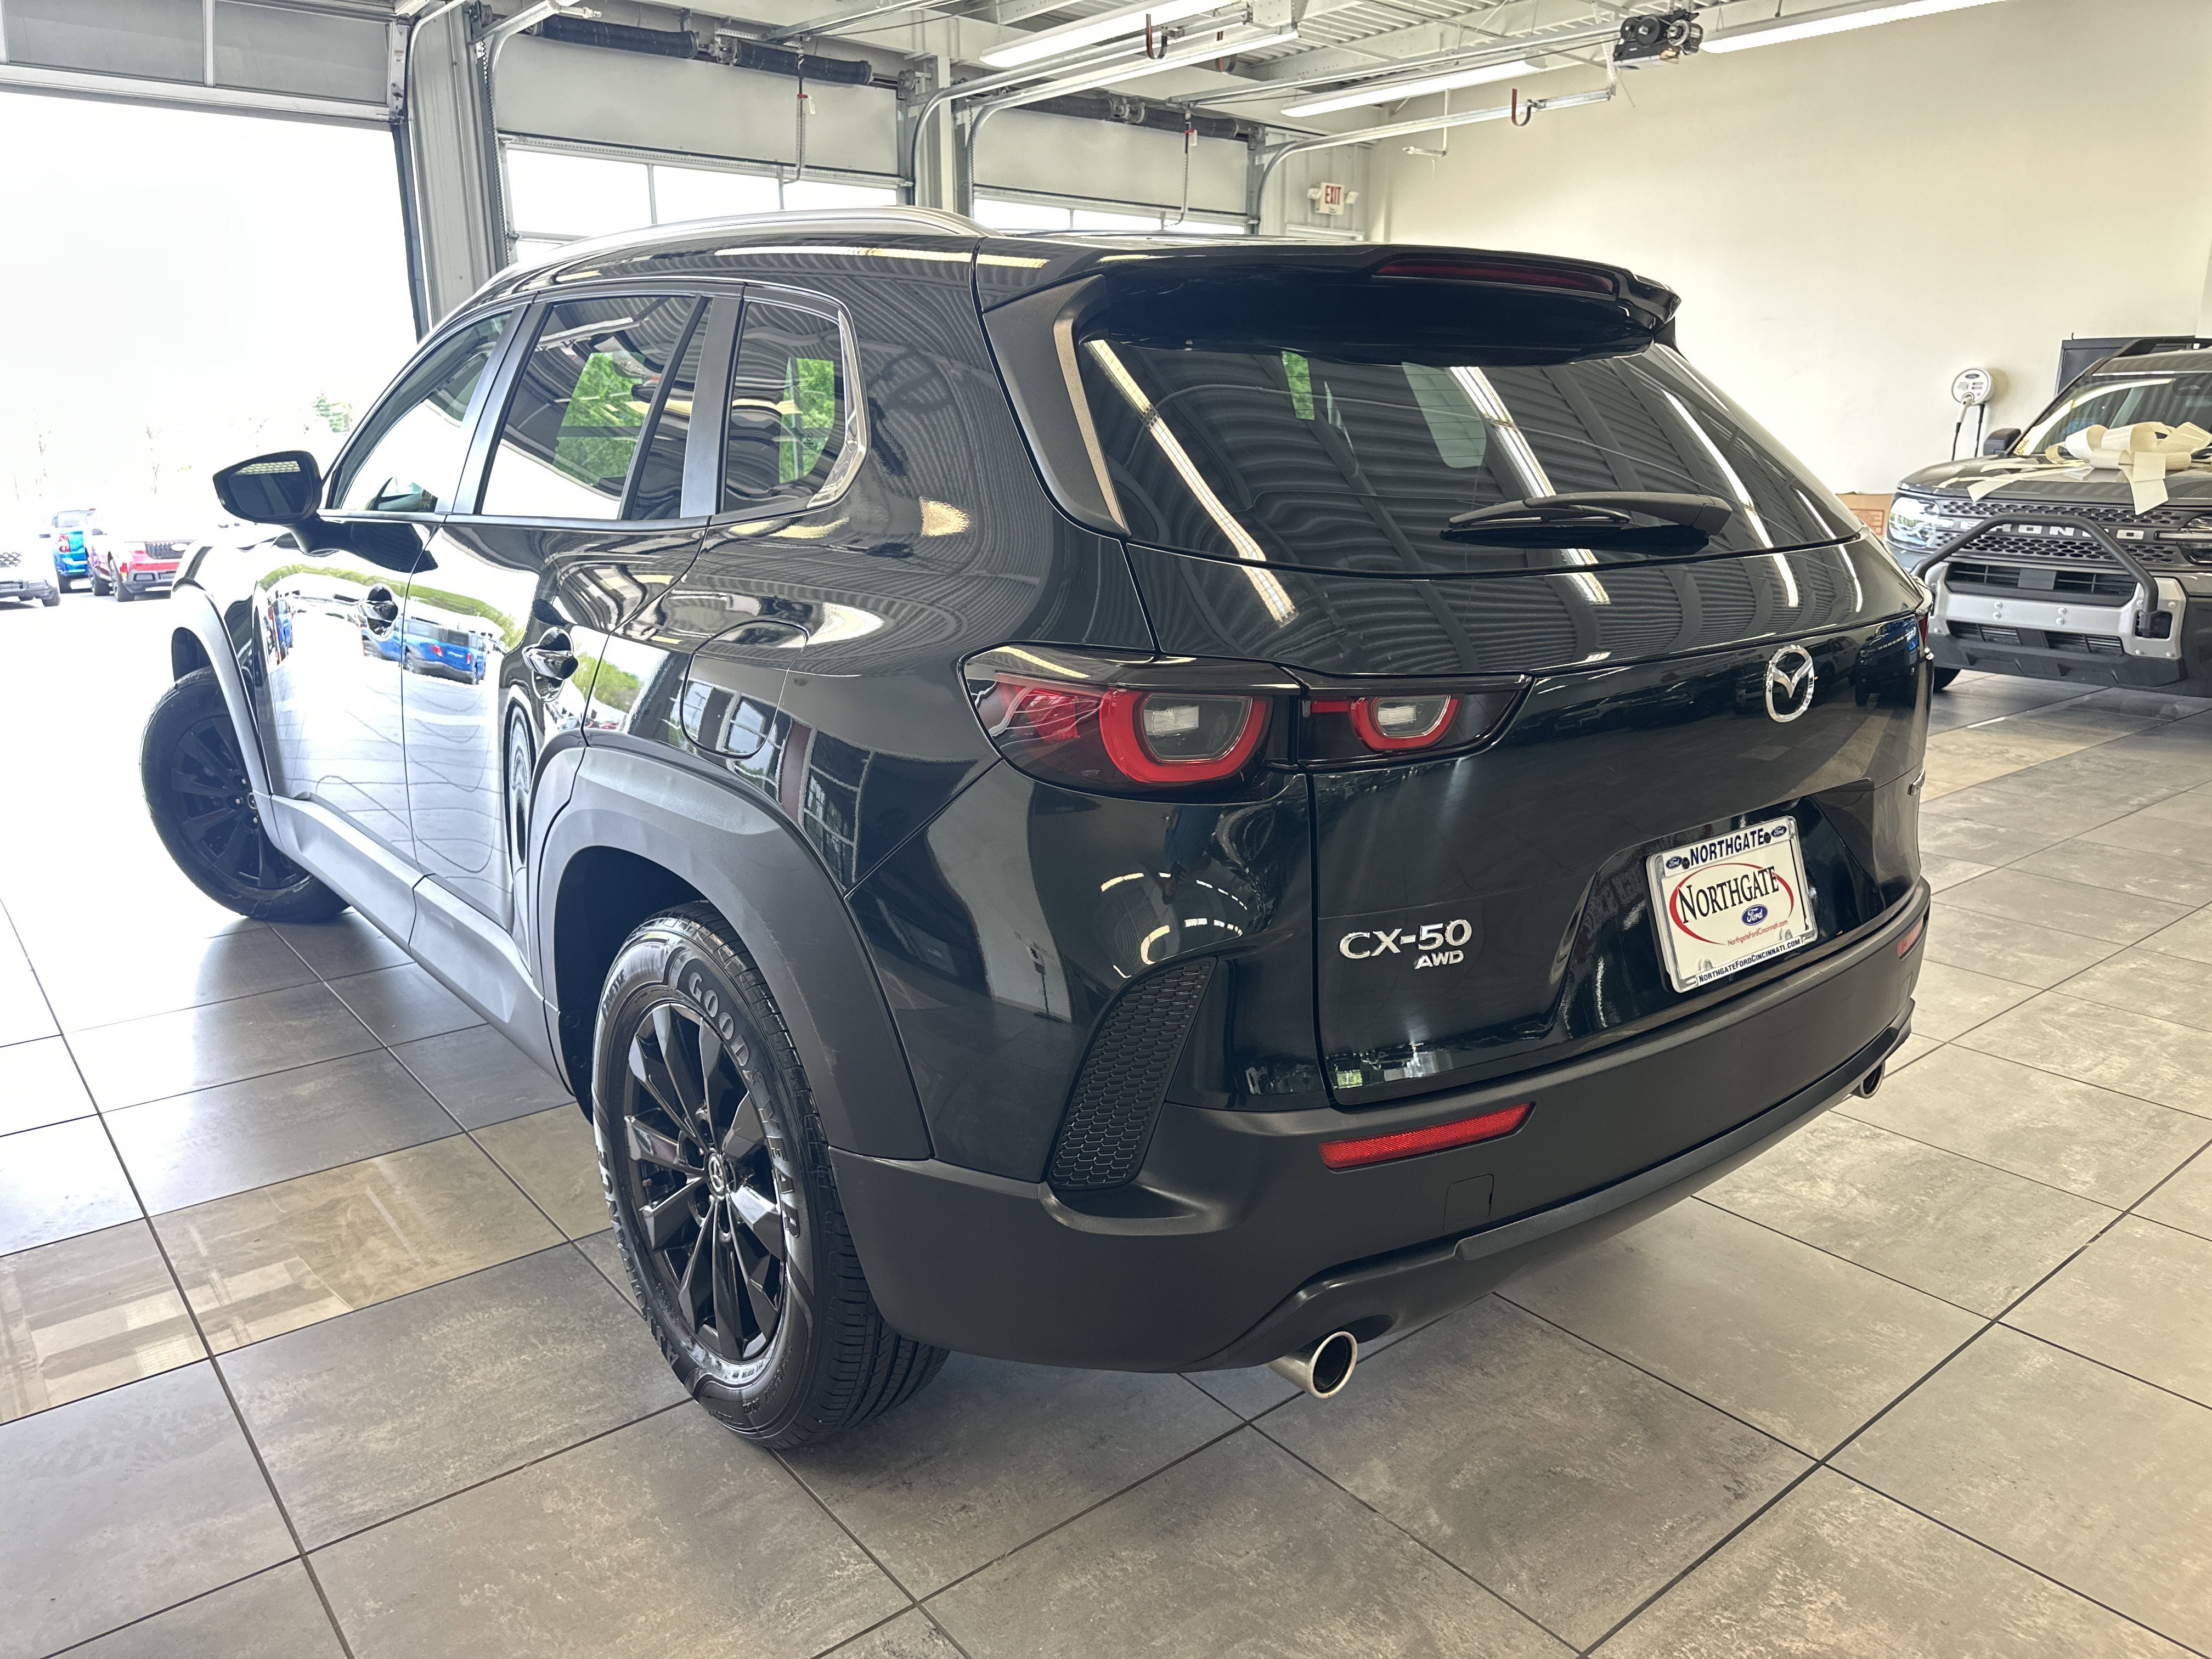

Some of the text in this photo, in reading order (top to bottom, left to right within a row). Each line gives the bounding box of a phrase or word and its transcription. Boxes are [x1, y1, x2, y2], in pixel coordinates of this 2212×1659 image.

[1325, 185, 1341, 205] EXIT
[1690, 828, 1764, 866] NORTHGATE
[1678, 866, 1779, 924] NORTHGATE
[1746, 907, 1764, 923] Ford
[1339, 918, 1472, 959] CX-50
[1727, 919, 1788, 946] NorthgateFordCincinnati.com
[1414, 950, 1464, 969] AWD
[1699, 938, 1801, 983] NORTHGATEFORDCINCINNATI.COM
